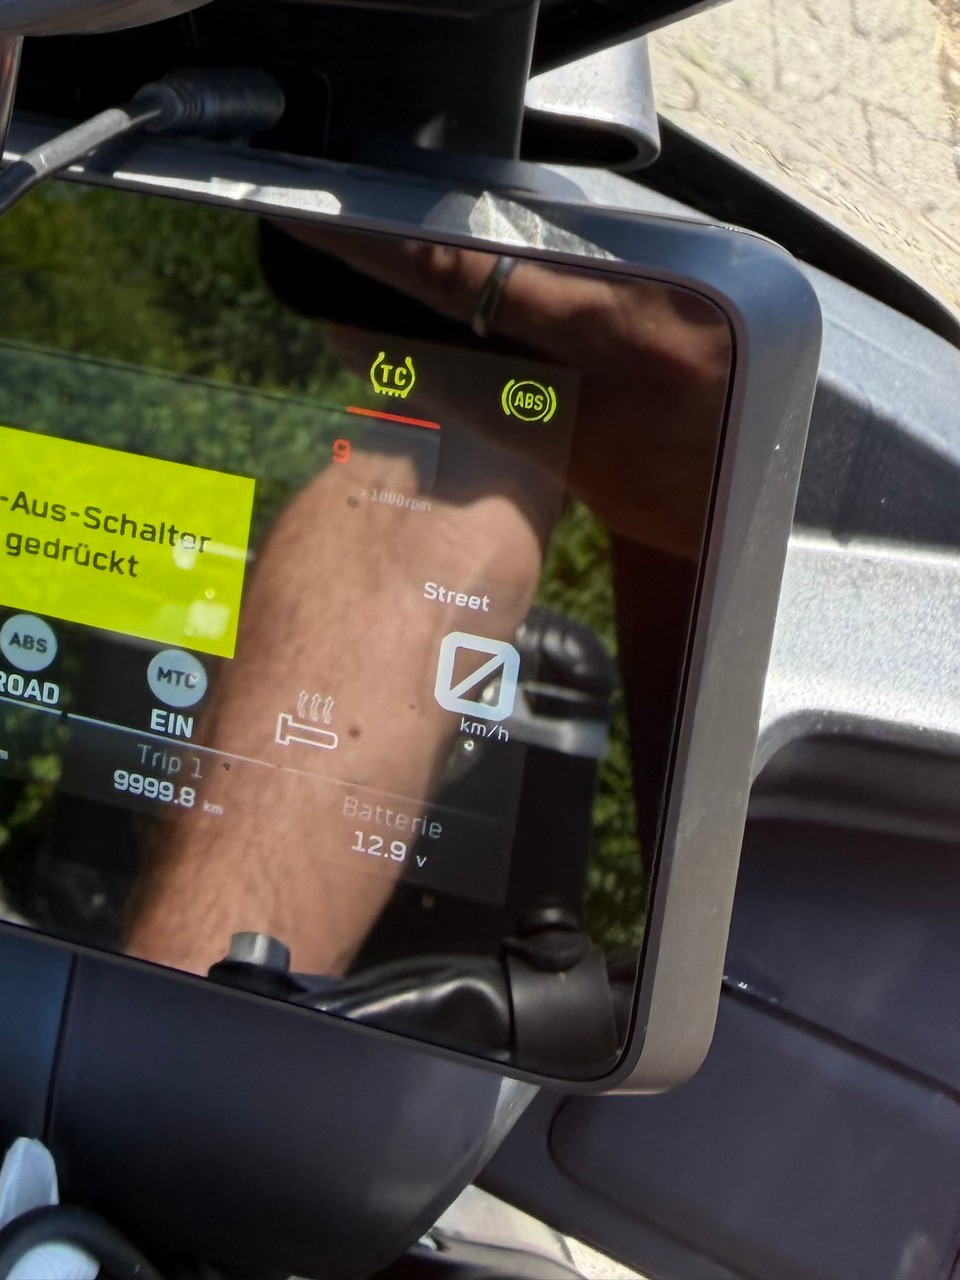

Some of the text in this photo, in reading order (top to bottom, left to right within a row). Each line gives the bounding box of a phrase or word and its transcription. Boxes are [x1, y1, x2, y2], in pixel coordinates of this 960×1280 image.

[380, 364, 408, 387] TC
[514, 391, 544, 411] ABS
[332, 438, 351, 463] 9
[6, 531, 139, 578] gedrückt
[423, 581, 491, 612] Street
[8, 631, 47, 654] ABS
[156, 666, 198, 690] MTC
[150, 708, 194, 738] EIN
[459, 717, 510, 742] km/h
[136, 743, 203, 779] Trip 1
[113, 769, 225, 816] 9999.8 km
[342, 795, 443, 839] Batterie
[351, 830, 407, 862] 12.9
